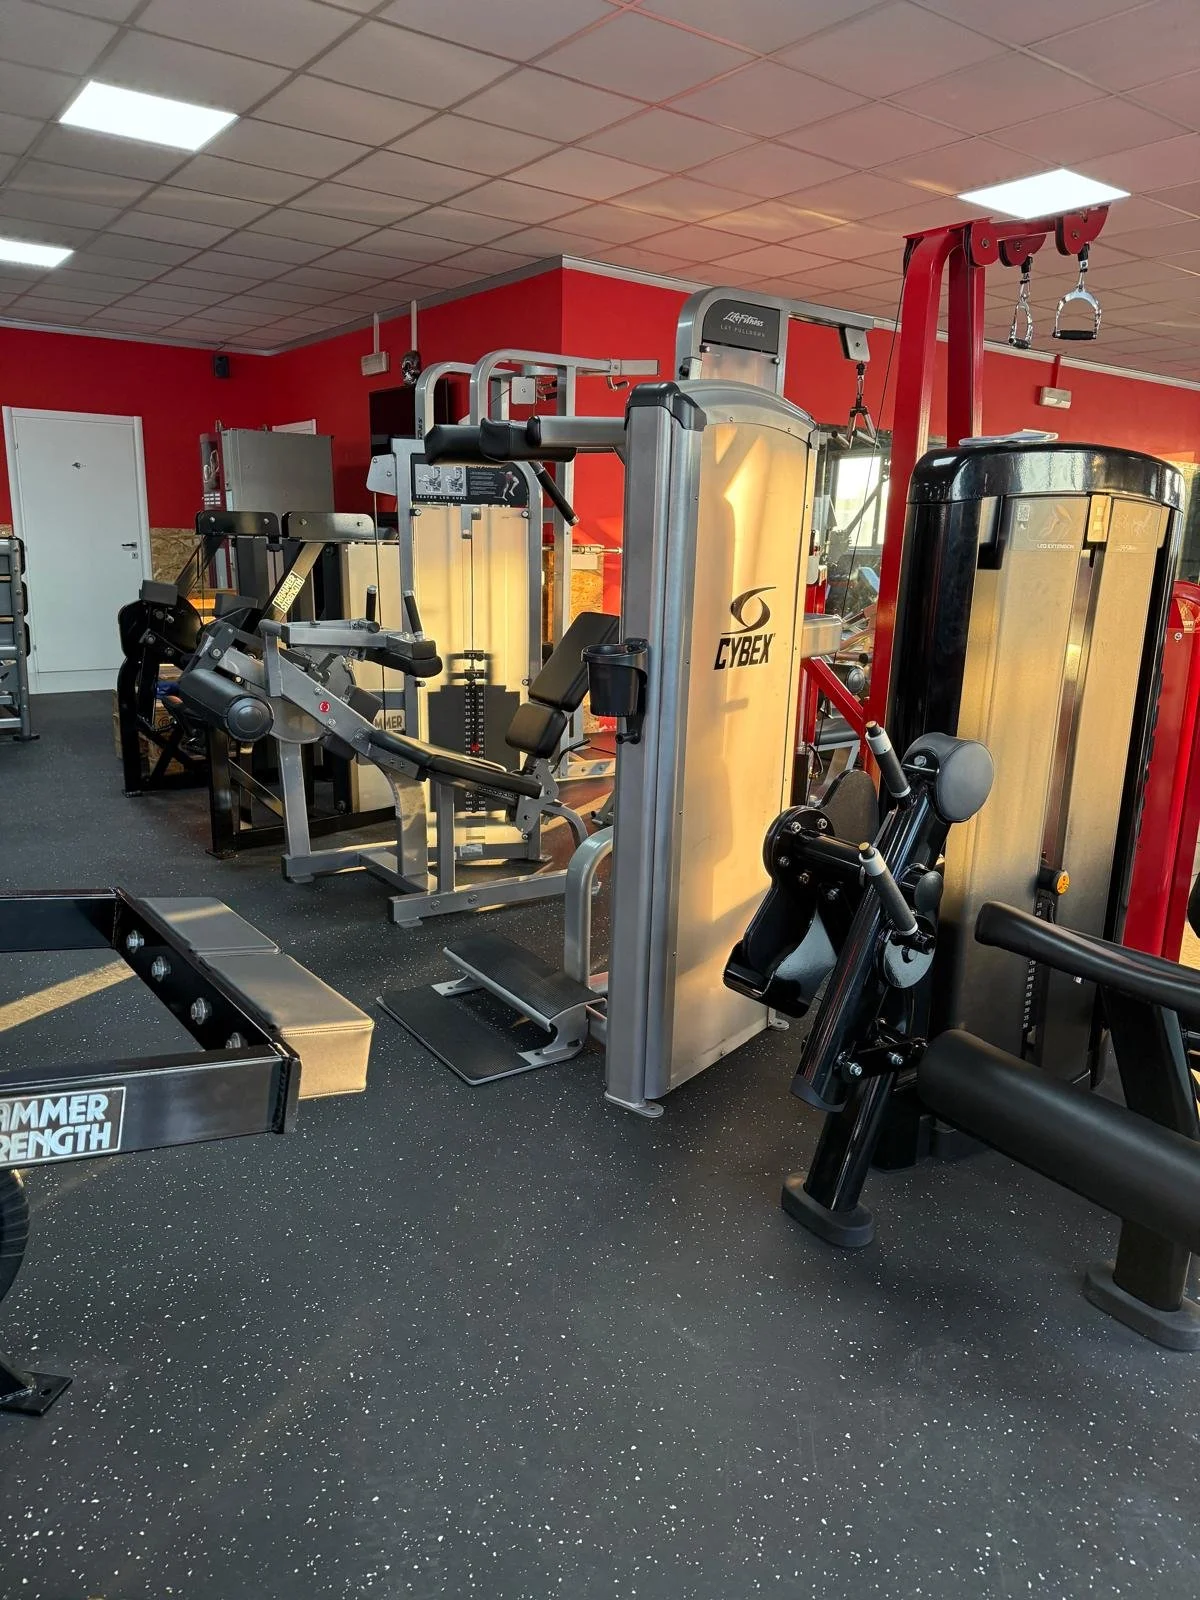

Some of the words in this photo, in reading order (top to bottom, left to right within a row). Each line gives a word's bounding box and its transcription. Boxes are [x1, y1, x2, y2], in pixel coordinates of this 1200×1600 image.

[714, 634, 773, 670] CYBEX
[375, 715, 403, 729] MMER
[0, 1094, 108, 1132] AMMER
[0, 1121, 112, 1161] RENGTH
